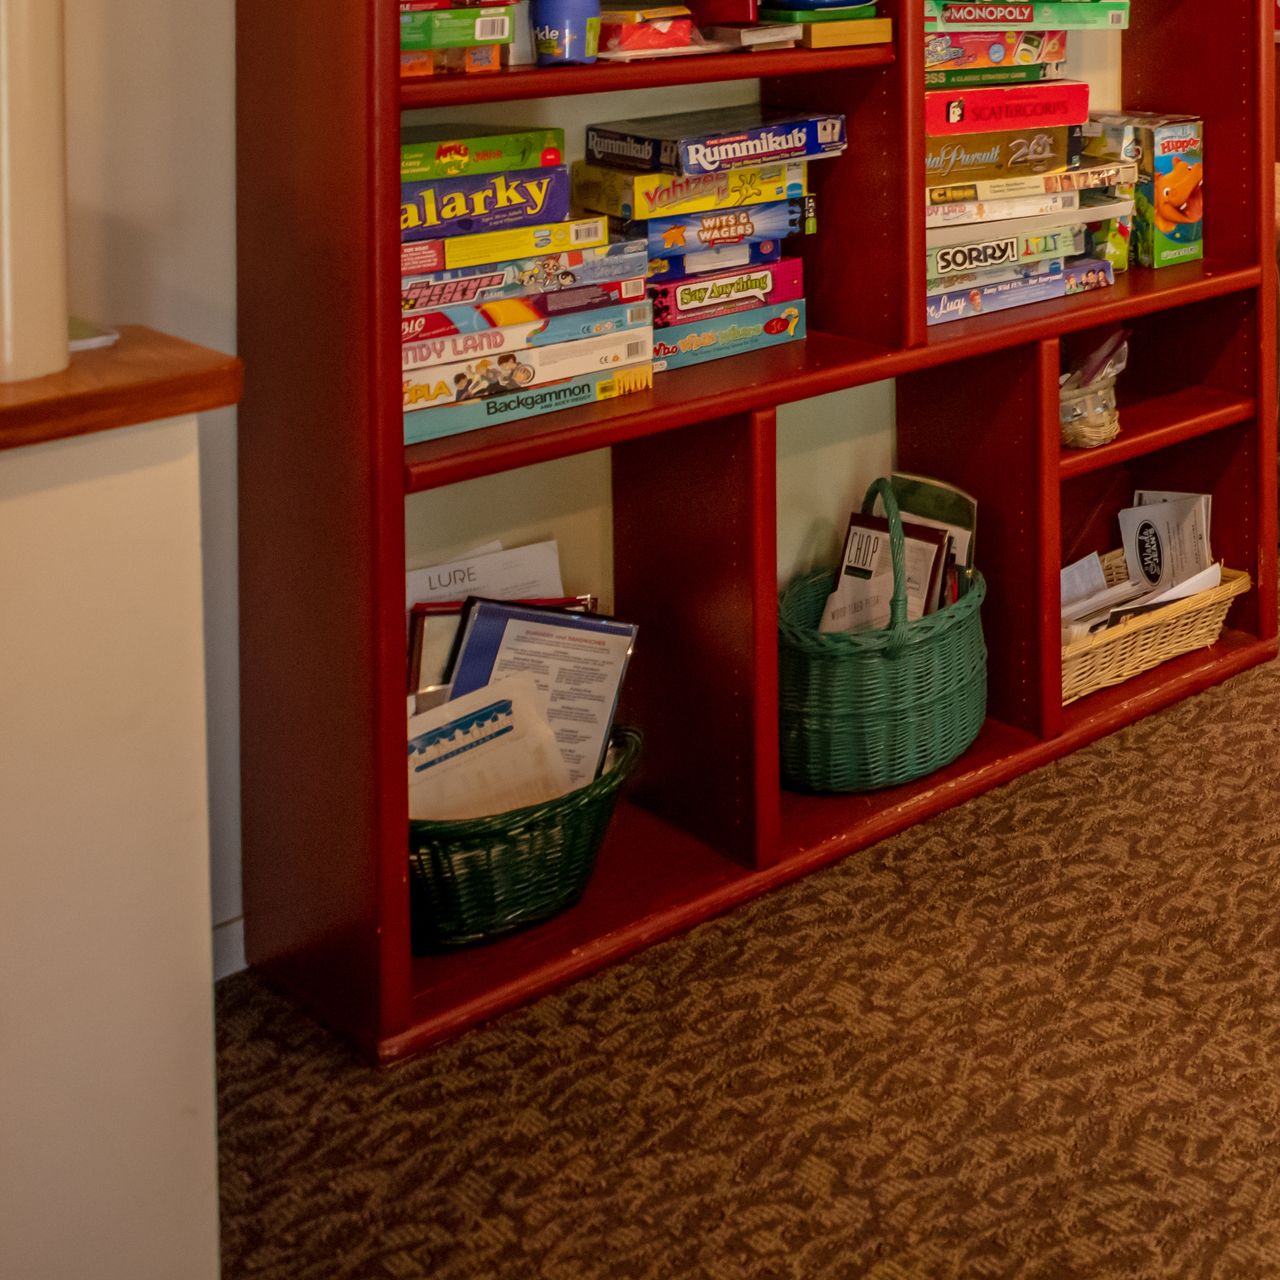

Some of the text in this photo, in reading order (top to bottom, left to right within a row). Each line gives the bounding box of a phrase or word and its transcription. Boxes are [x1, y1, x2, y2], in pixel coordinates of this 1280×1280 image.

[951, 7, 1031, 20] MONOPOLY
[587, 130, 653, 160] Rummikub
[687, 128, 806, 171] Rummikub
[946, 144, 1001, 176] Pursuit
[401, 175, 552, 231] alarky
[644, 172, 728, 212] Yahtzee
[699, 222, 753, 240] WAGERS
[702, 214, 736, 228] WITS
[940, 240, 1015, 270] SORRY!
[680, 274, 769, 305] Say Anything
[935, 295, 966, 319] Lucy
[402, 331, 505, 365] NDY LAND
[486, 383, 591, 416] Backgammon
[847, 531, 879, 567] CHOP
[428, 566, 477, 591] LURE
